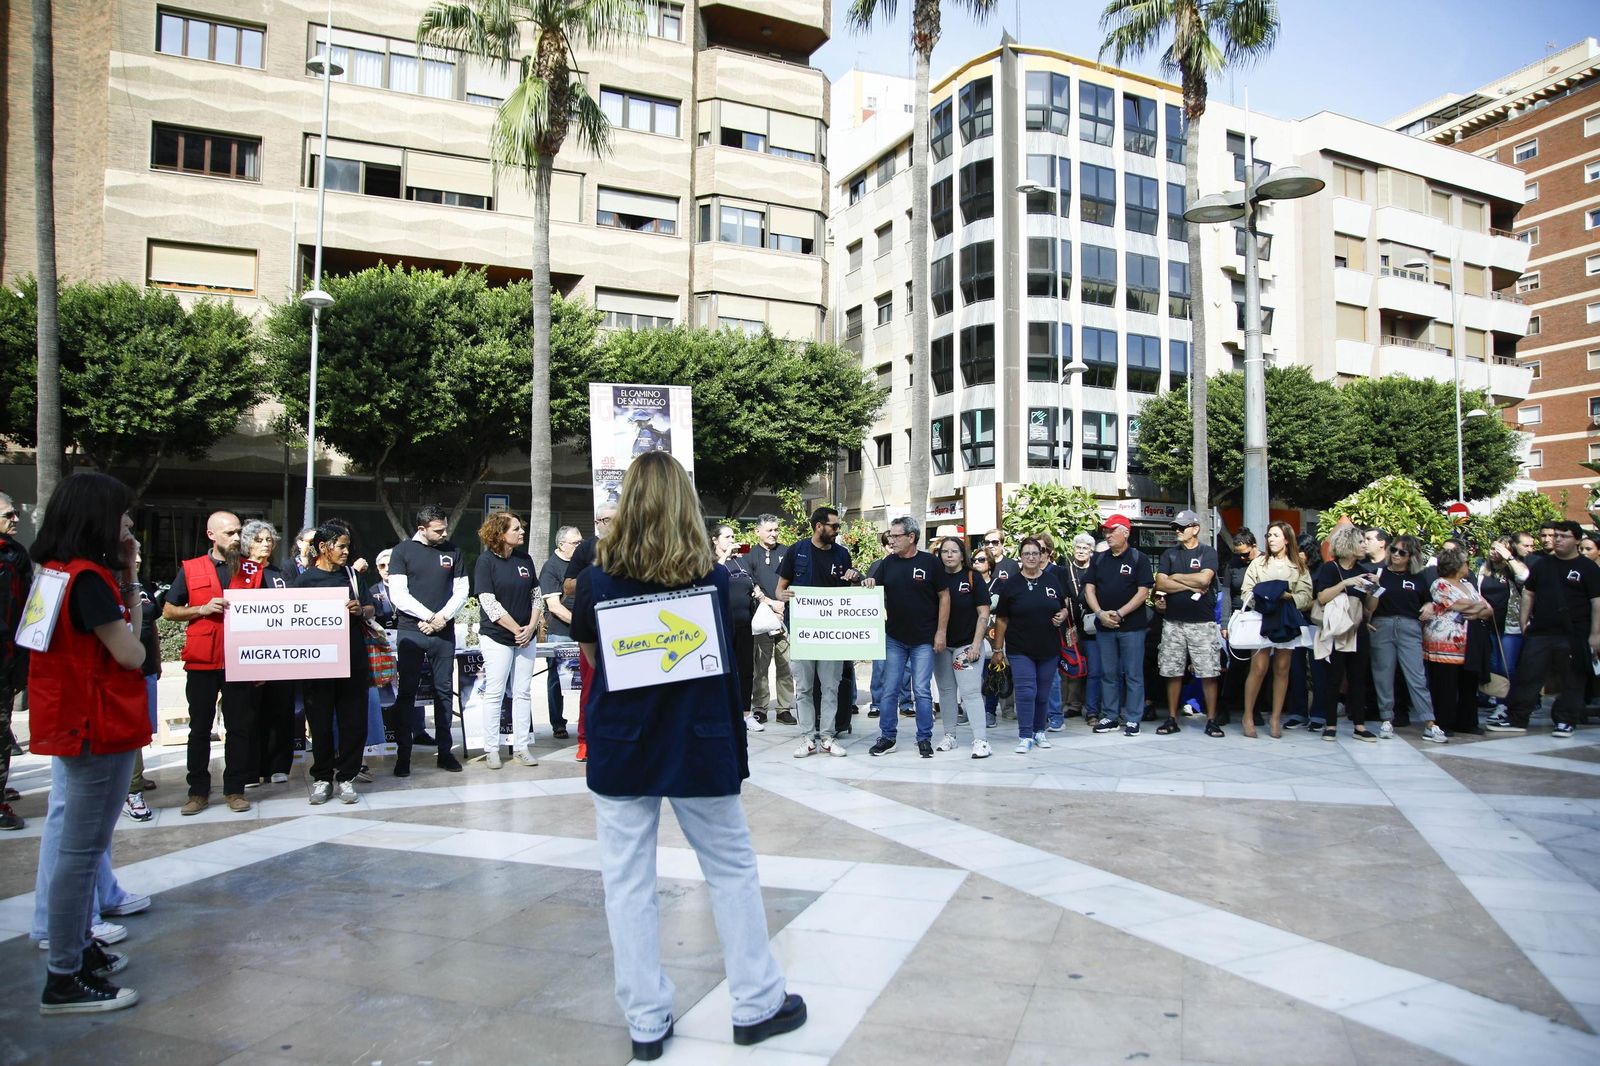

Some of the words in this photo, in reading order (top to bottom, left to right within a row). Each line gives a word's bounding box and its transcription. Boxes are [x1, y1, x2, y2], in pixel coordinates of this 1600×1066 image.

[620, 389, 628, 397] EL
[628, 389, 661, 398] CAMINO
[617, 397, 627, 405] DE
[627, 398, 666, 406] SANTIAGO
[795, 597, 834, 606] VENIMOS
[840, 598, 852, 606] DE
[234, 604, 285, 614] VENIMOS
[293, 603, 309, 613] DE
[819, 609, 832, 617] UN
[838, 608, 879, 617] PROCESO
[266, 618, 283, 627] UN
[290, 616, 343, 627] PROCESO
[618, 640, 651, 651] Buen
[655, 629, 701, 645] Camino
[798, 630, 811, 639] de
[812, 631, 871, 640] ADICCIONES
[240, 648, 321, 660] MIGRATORIO
